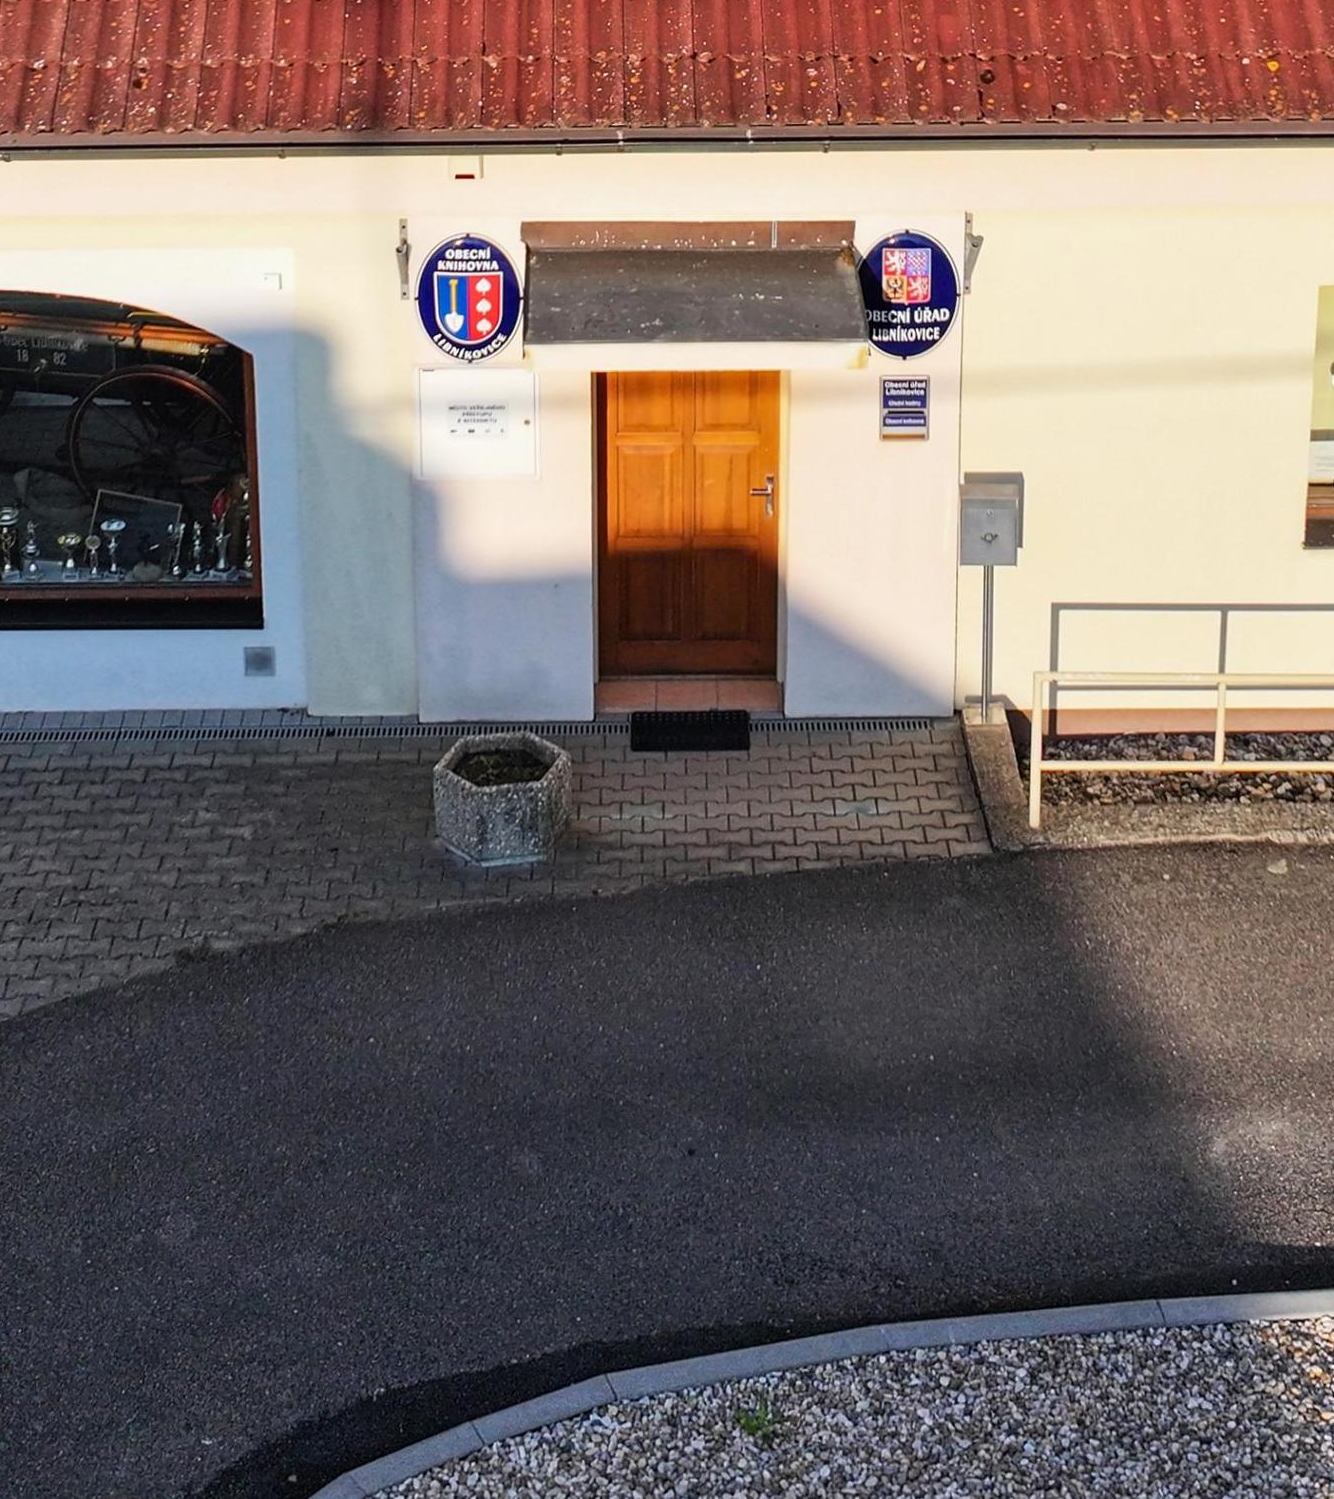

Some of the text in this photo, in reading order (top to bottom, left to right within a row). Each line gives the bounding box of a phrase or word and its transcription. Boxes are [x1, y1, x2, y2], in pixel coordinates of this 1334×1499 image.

[445, 246, 491, 260] OBECNÍ
[436, 260, 499, 272] KNIHOVNA
[866, 306, 951, 324] OBECNÍ ÚŘAD
[871, 325, 941, 343] LIBNÍKOVICE
[432, 332, 508, 361] LIBNÍKOVICE
[52, 351, 68, 367] 82
